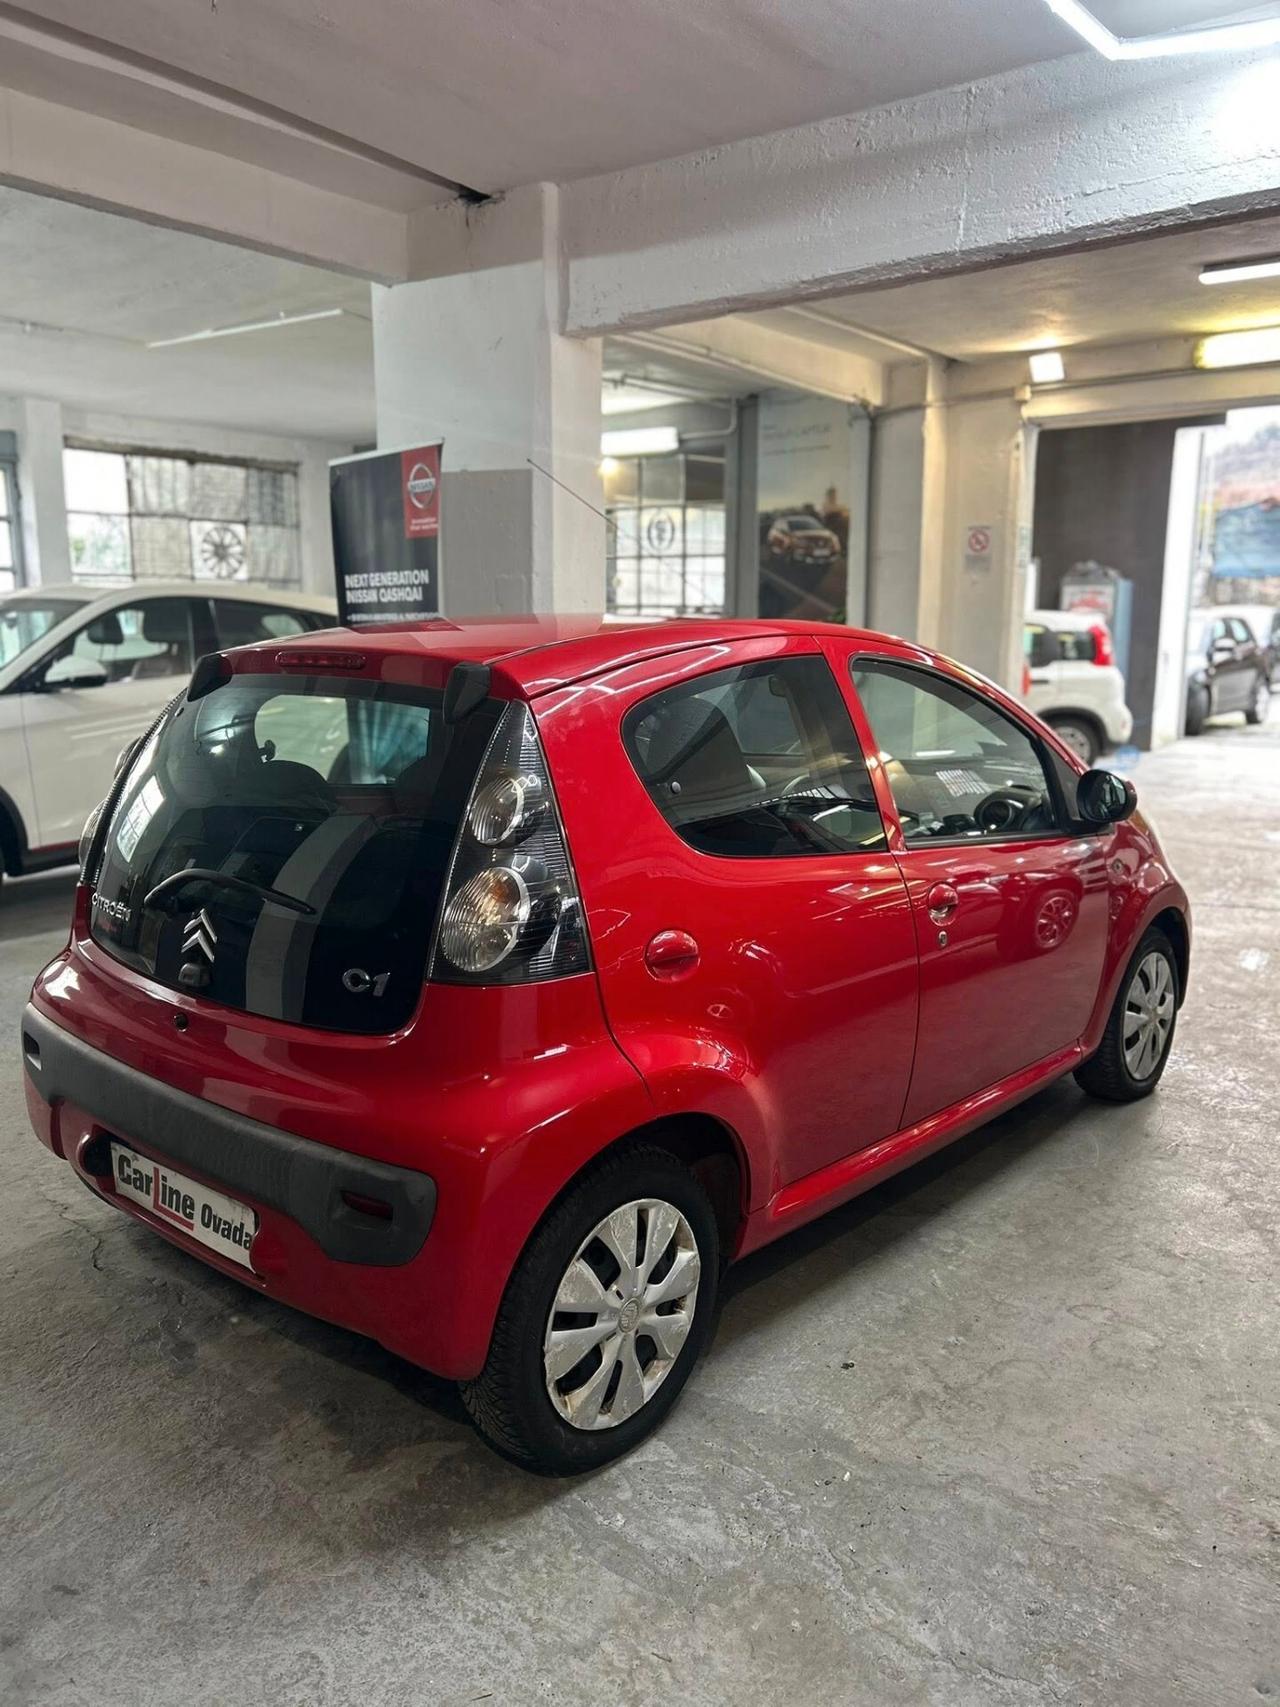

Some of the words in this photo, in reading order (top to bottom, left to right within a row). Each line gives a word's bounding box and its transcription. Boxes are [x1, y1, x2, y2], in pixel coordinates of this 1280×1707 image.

[344, 573, 369, 589] NEXT
[369, 569, 429, 587] GENERATION
[346, 588, 378, 604] NISSAN
[379, 586, 423, 603] QASHQAI
[200, 1203, 252, 1250] Ovada
